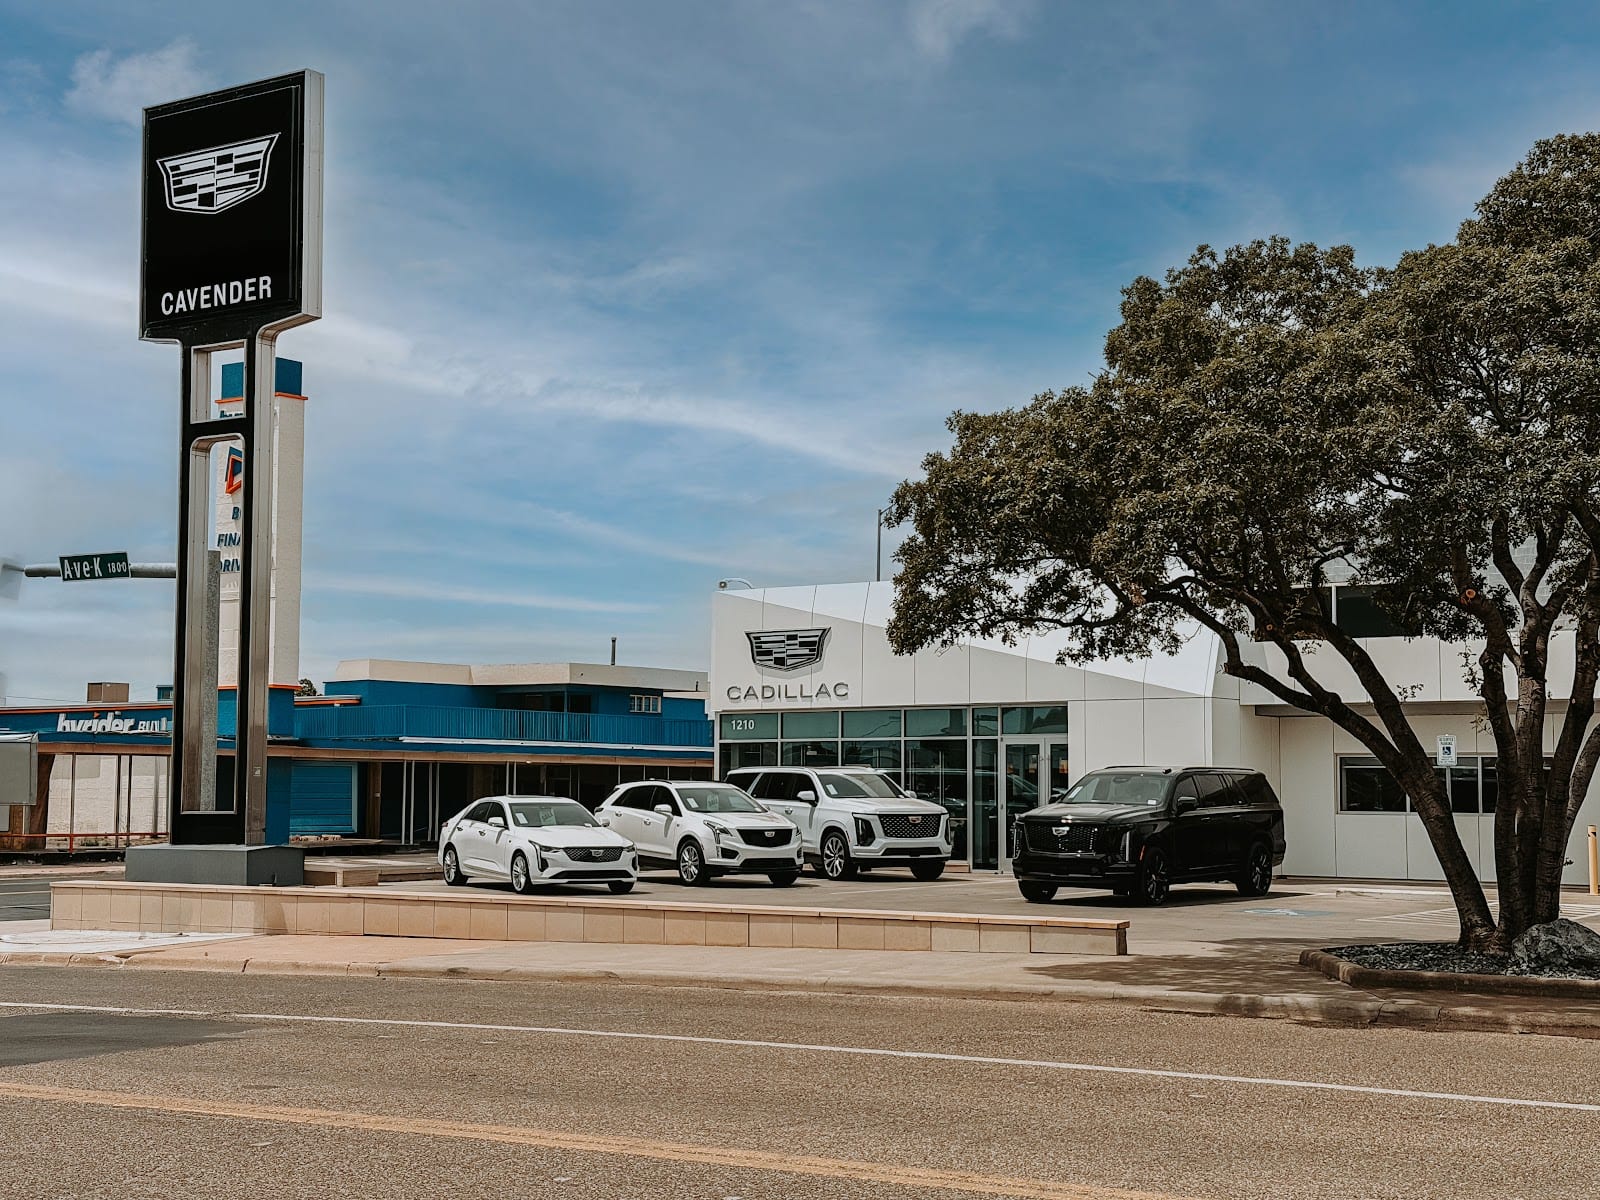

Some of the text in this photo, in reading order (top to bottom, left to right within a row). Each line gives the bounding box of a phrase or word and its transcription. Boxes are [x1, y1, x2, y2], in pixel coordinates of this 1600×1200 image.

[161, 275, 272, 316] CAVENDER
[93, 557, 103, 577] K
[107, 561, 127, 573] 1800
[726, 682, 849, 701] CADILLAC
[731, 719, 755, 731] 1210
